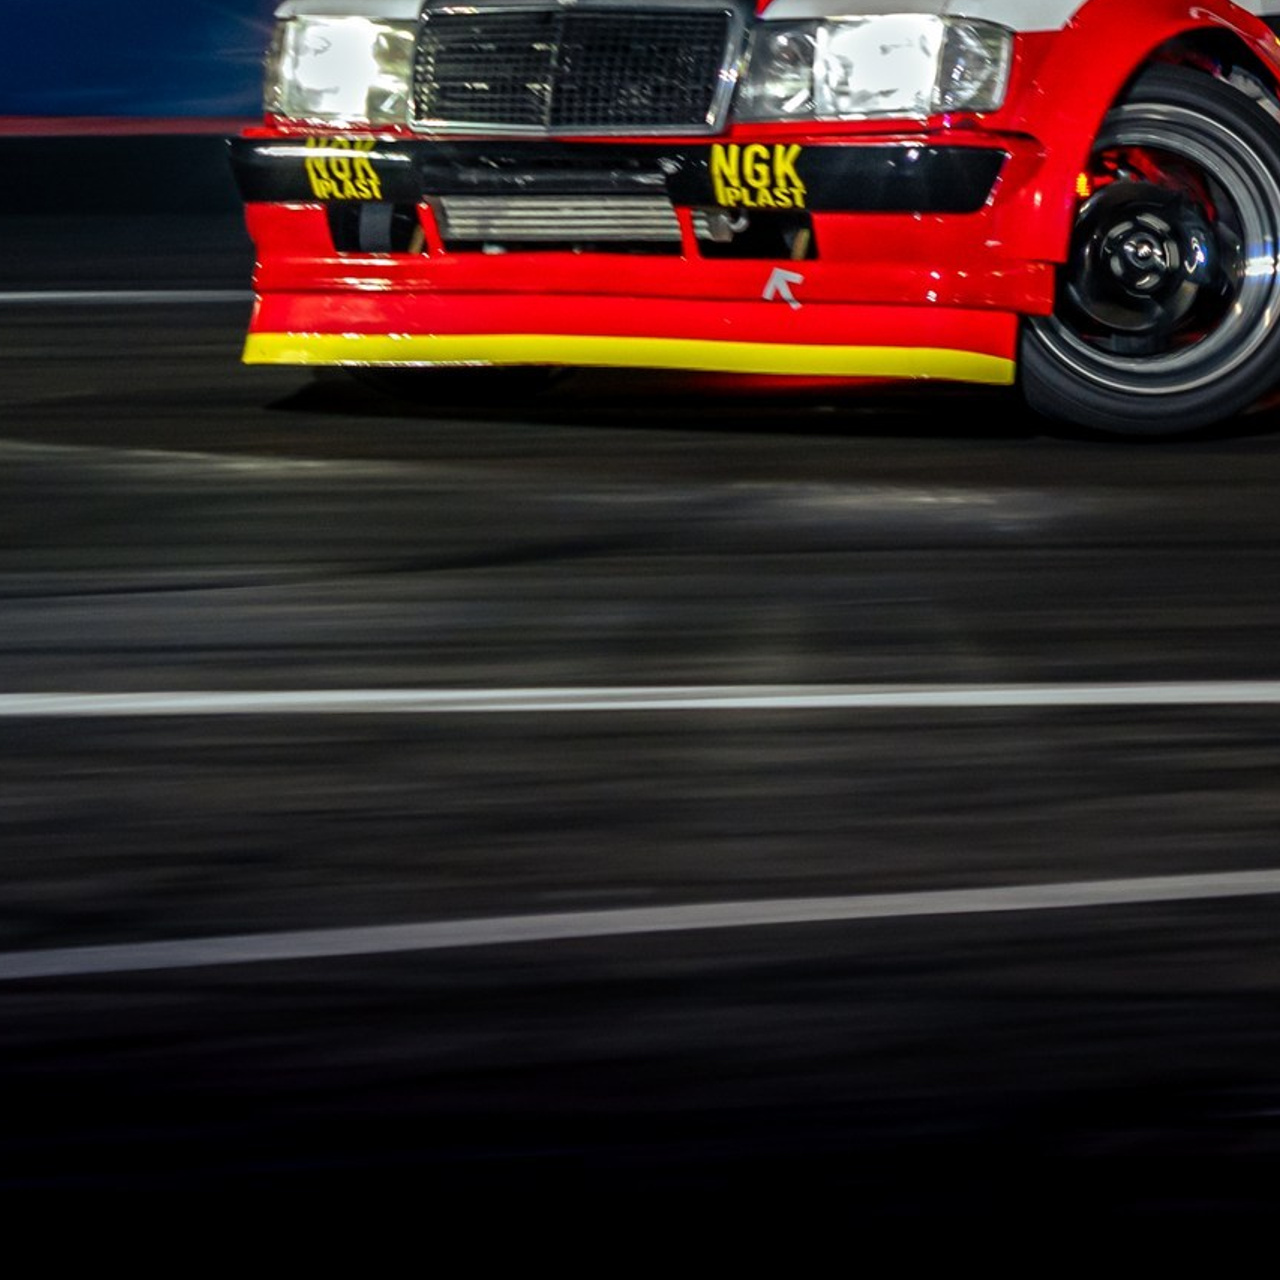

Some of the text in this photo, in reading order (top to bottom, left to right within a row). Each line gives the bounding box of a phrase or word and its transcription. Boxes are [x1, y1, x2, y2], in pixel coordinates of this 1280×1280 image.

[710, 143, 805, 190] NGK
[317, 178, 382, 199] PLAST
[725, 186, 808, 208] PLAST
